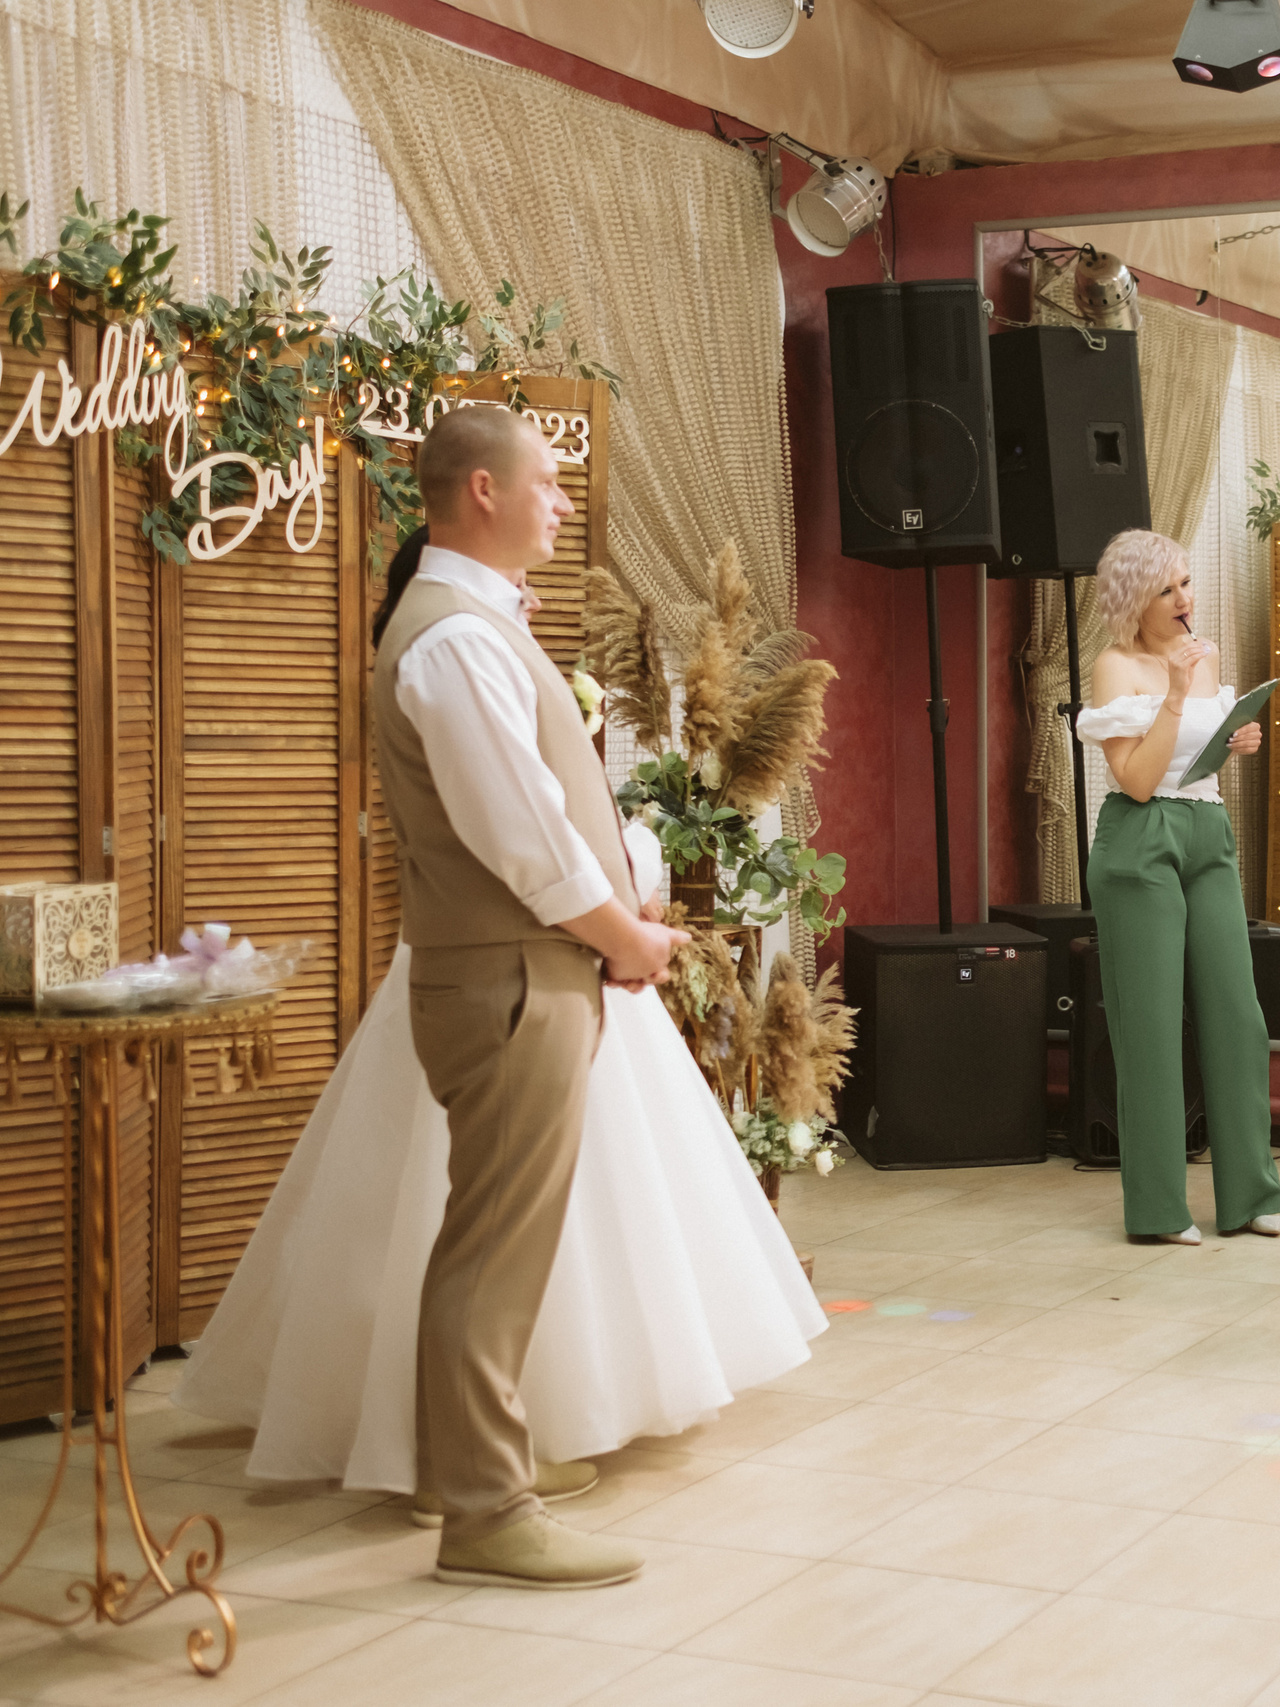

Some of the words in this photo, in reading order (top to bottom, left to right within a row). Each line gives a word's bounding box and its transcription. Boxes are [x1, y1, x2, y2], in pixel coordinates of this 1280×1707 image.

[0, 318, 190, 481] Wedding
[171, 415, 327, 560] Day!
[1004, 948, 1016, 959] 18
